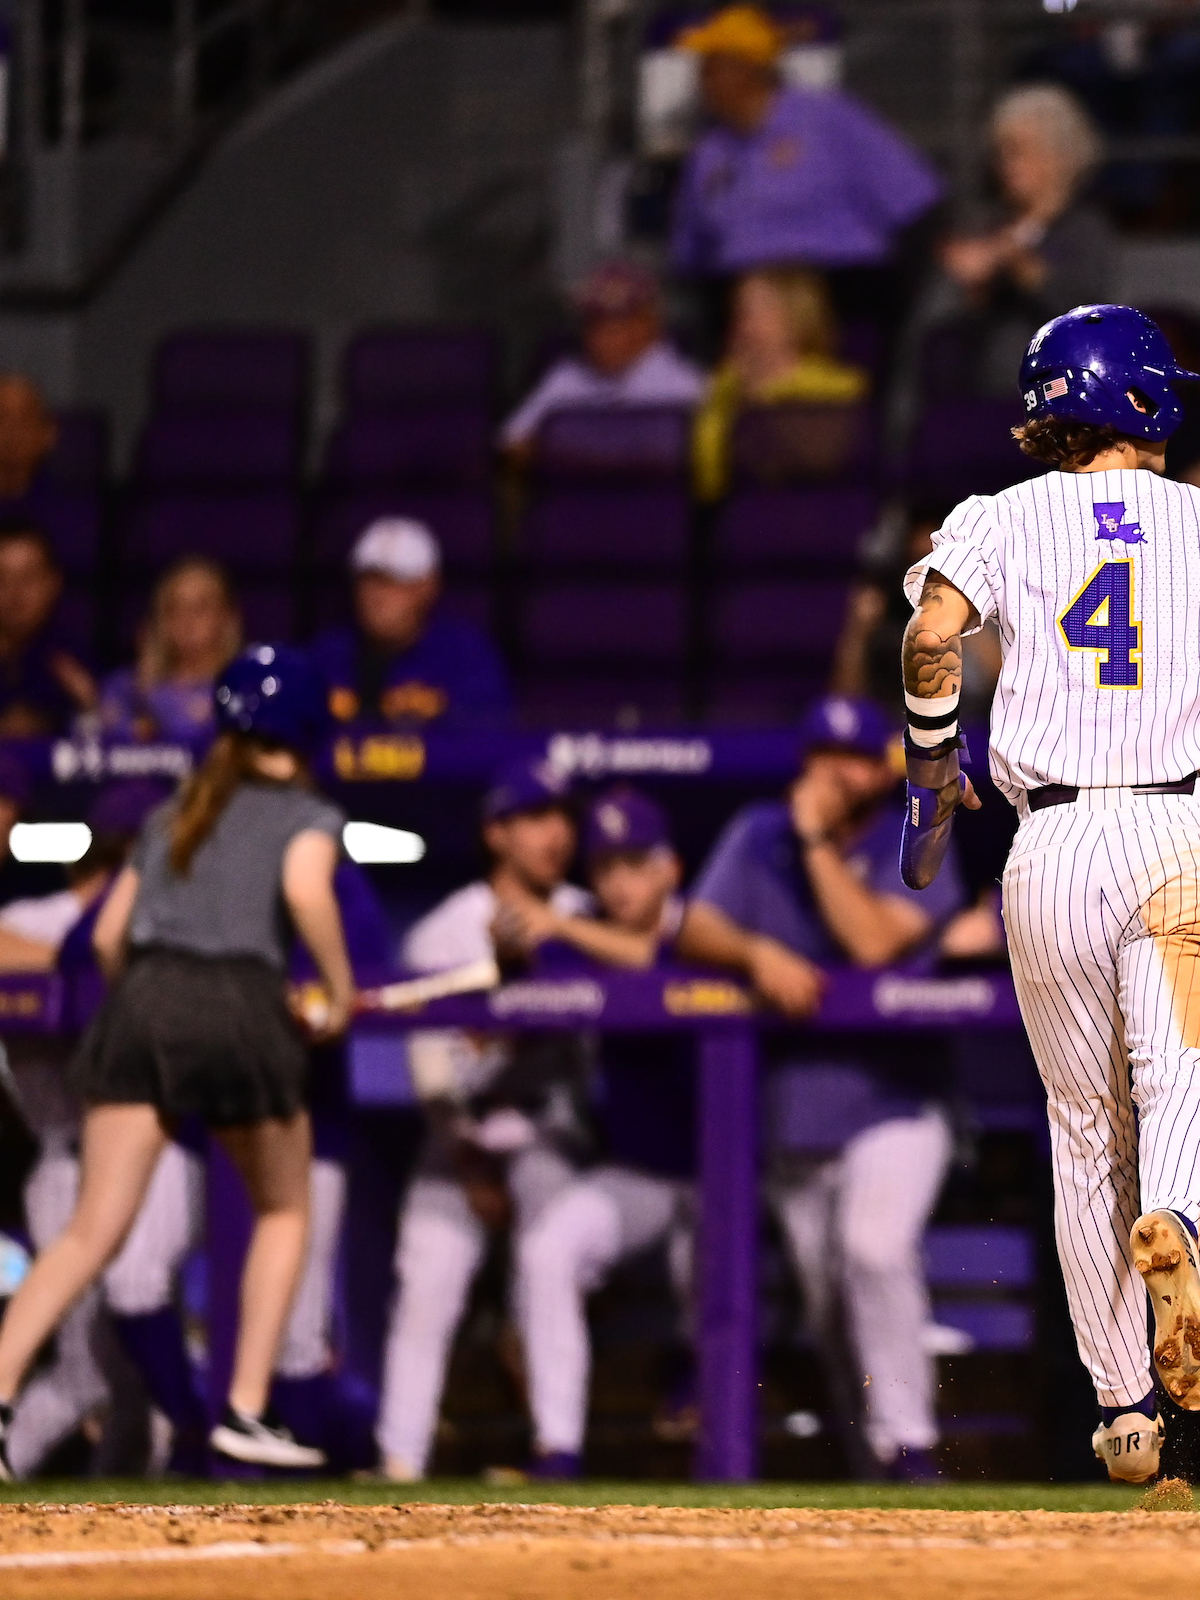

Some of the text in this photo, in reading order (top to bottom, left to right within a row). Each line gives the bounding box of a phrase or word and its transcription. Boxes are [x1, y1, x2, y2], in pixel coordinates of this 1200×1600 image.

[1024, 389, 1037, 412] 39
[1101, 513, 1120, 533] LSU
[1056, 558, 1142, 691] 4
